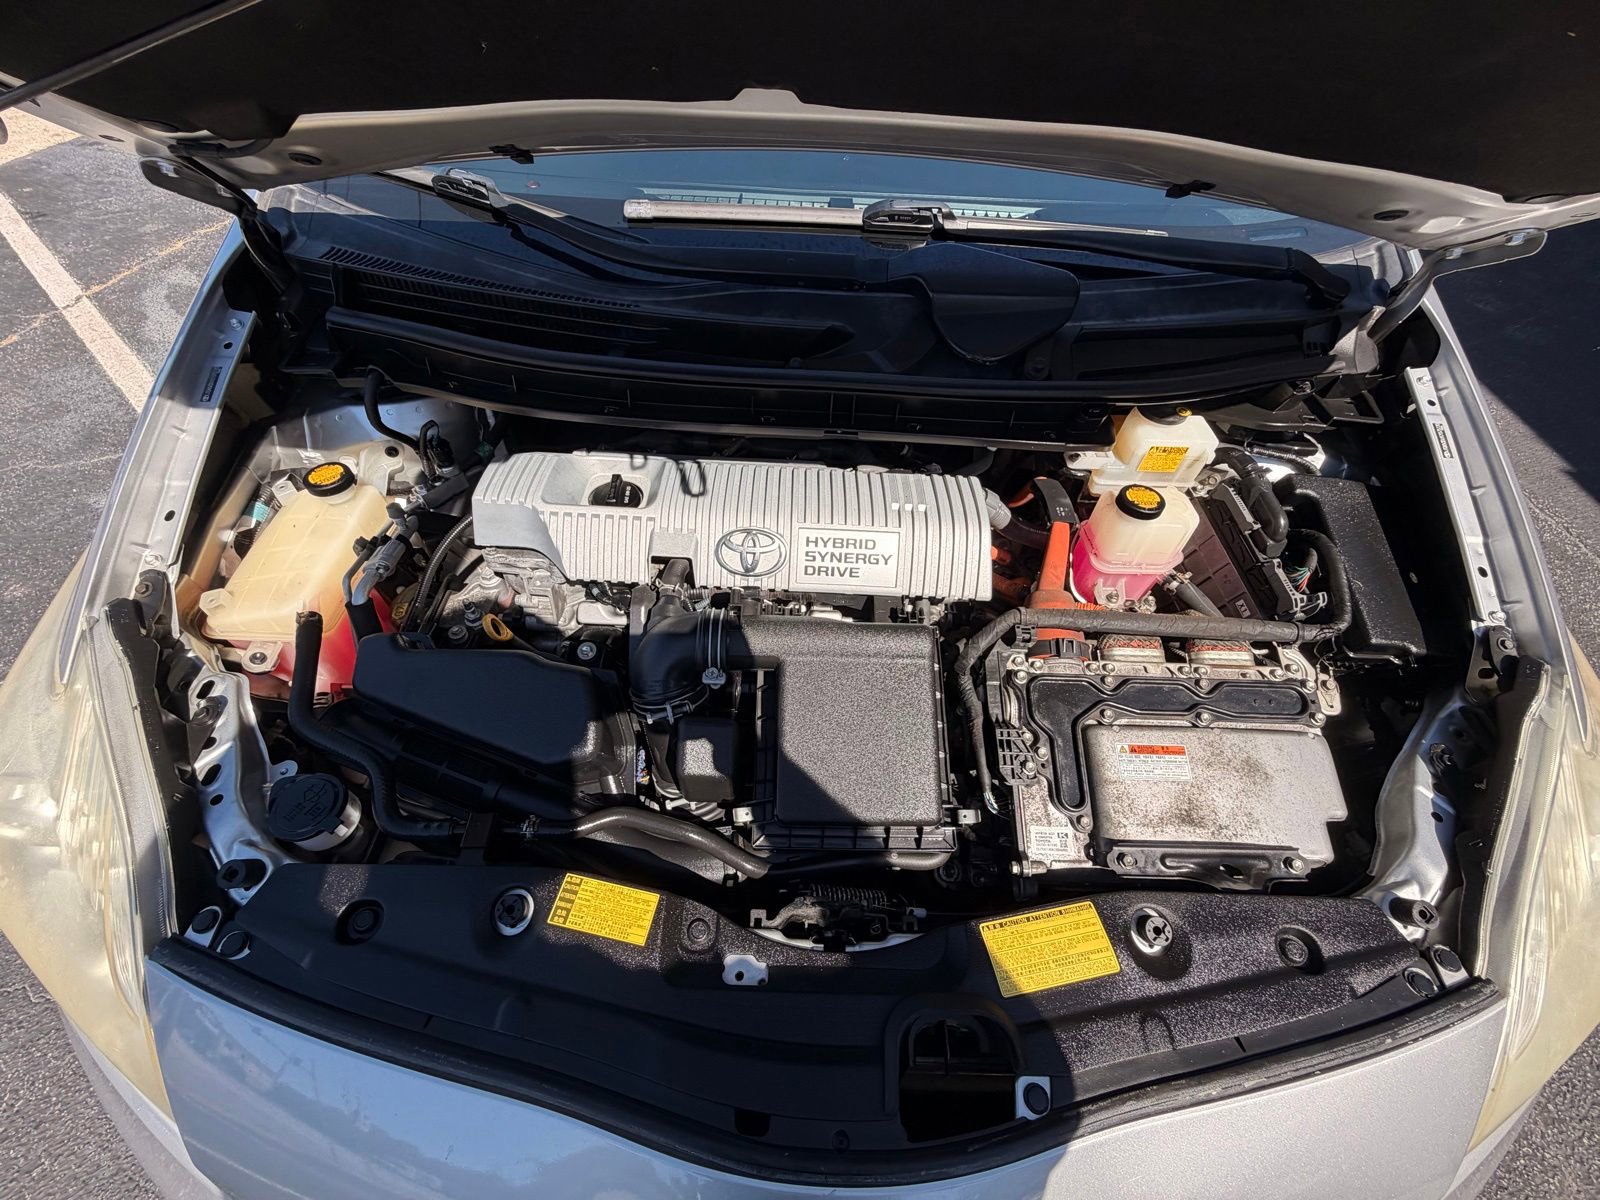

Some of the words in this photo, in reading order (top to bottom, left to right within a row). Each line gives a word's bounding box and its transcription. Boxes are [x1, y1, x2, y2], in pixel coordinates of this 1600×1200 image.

[805, 536, 877, 550] HYBRID
[804, 550, 894, 566] SYNERGY
[803, 565, 861, 578] DRIVE
[1002, 916, 1028, 927] CAUTION
[1029, 911, 1060, 922] ATTENTION
